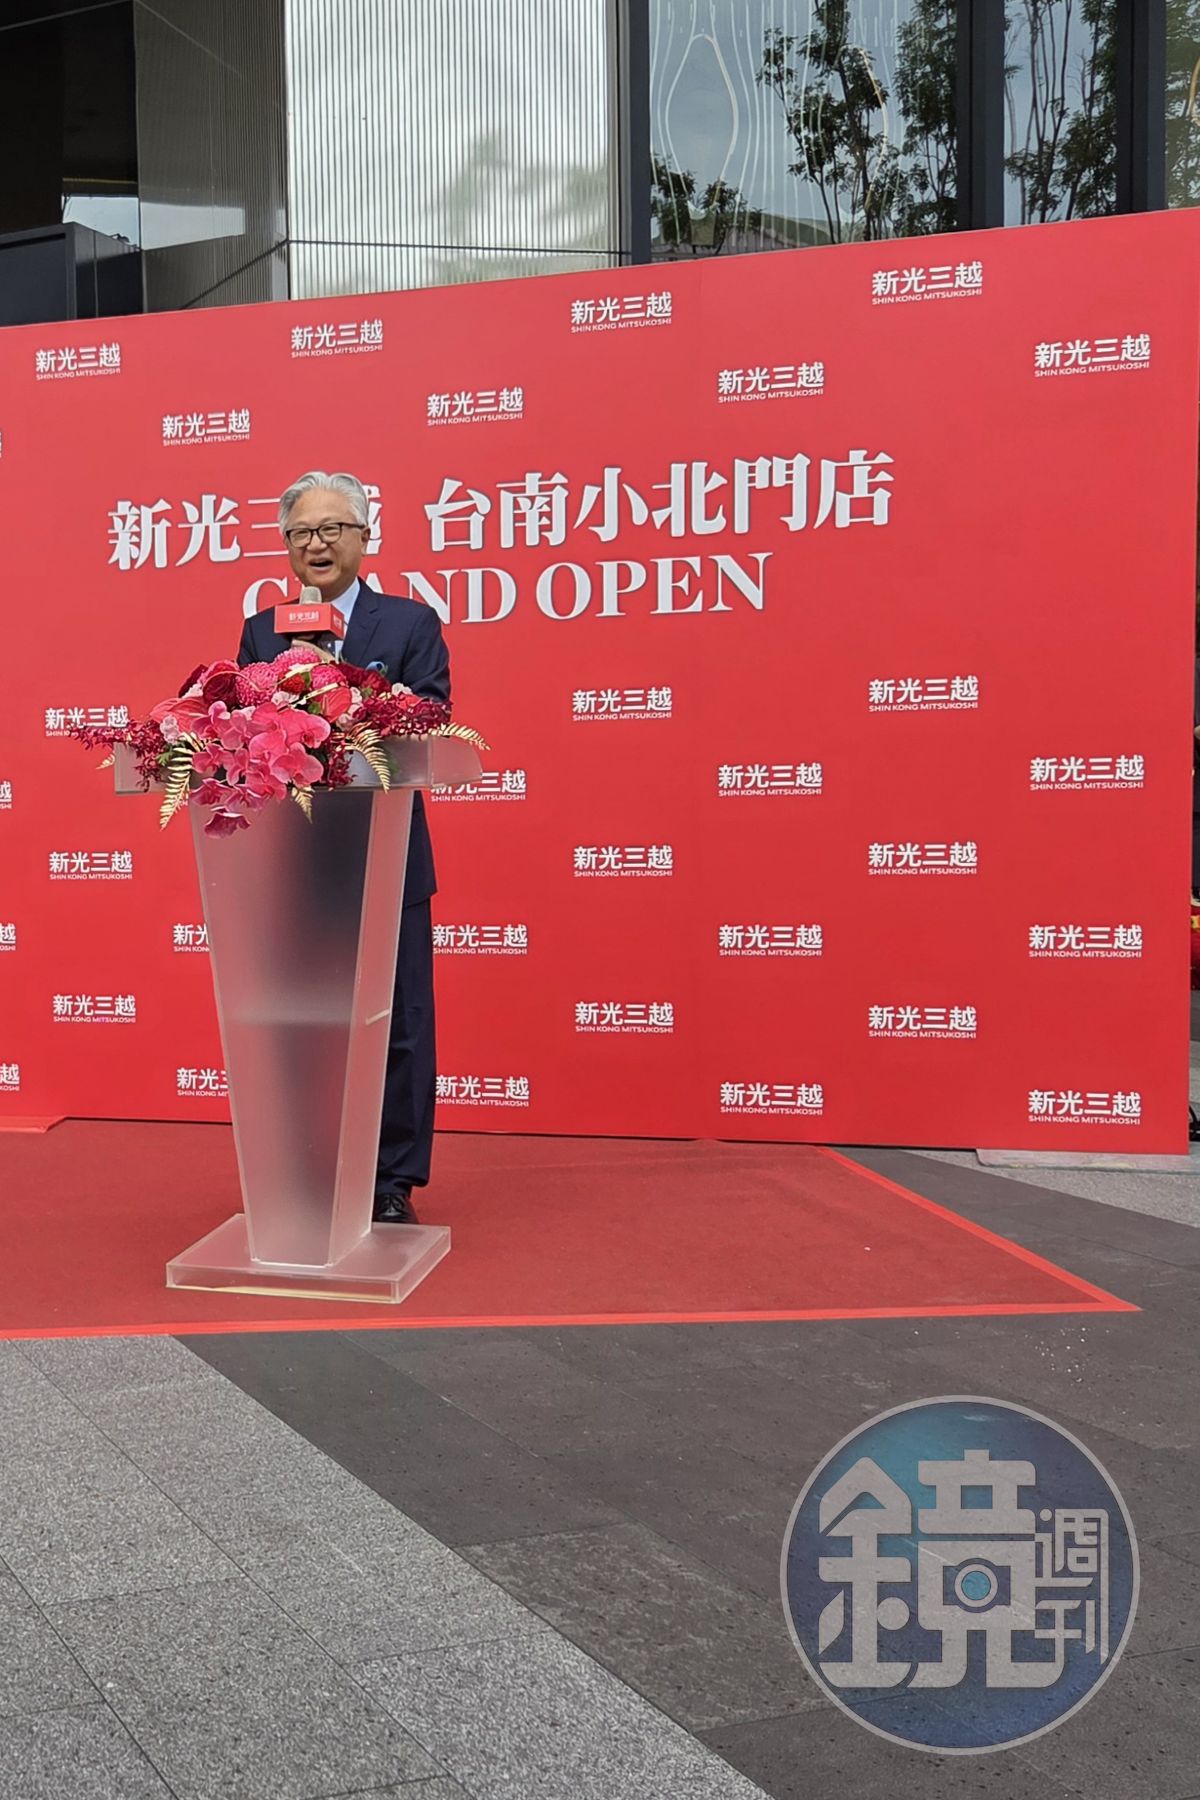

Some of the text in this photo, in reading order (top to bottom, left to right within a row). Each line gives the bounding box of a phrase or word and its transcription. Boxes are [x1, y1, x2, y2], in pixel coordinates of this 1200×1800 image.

[872, 261, 982, 295] 新光三越
[571, 291, 672, 323] 新光三越
[872, 288, 982, 305] SHIN KONG MITSUKOSHI
[292, 319, 383, 349] 新光三越
[571, 318, 671, 333] SHIN KONG MITSUKOSHI
[36, 342, 120, 371] 新光三越
[292, 344, 382, 358] SHIN KONG MITSUKOSHI
[1035, 334, 1150, 367] 新光三越
[54, 371, 75, 379] KONG
[76, 368, 120, 377] MITSUKOSHI
[718, 361, 824, 393] 新光三越
[1035, 361, 1149, 377] SHIN KONG MITSUKOSHI
[427, 387, 523, 416] 新光三越
[719, 388, 823, 403] SHIN KONG MITSUKOSHI
[163, 408, 250, 436] 新光三越
[448, 416, 471, 424] KONG
[472, 413, 522, 422] MITSUKOSHI
[163, 434, 249, 446] SHIN KONG MITSUKOSHI
[107, 449, 894, 571] 新光三 台南小北門店
[536, 552, 773, 621] OPEN
[573, 686, 672, 711] 新光三越
[869, 675, 978, 702] 新光三越
[45, 705, 130, 729] 新光三越
[573, 713, 593, 721] SHIN
[619, 711, 671, 720] MITSUKOSHI
[869, 702, 977, 712] SHIN KONG MITSUKOSHI
[718, 762, 822, 789] 新光三越
[1030, 754, 1144, 782] 新光三越
[740, 788, 765, 796] KONG
[1030, 781, 1143, 790] SHIN KONG MITSUKOSHI
[49, 851, 132, 873] 新光三越
[574, 845, 673, 869] 新光三越
[869, 841, 977, 867] 新光三越
[919, 867, 976, 875] MITSUKOSHI
[433, 925, 527, 948] 新光三越
[719, 924, 822, 949] 新光三越
[1029, 924, 1142, 950] 新光三越
[477, 947, 527, 955] MITSUKOSHI
[1081, 950, 1141, 958] MITSUKOSHI
[53, 994, 136, 1015] 新光三越
[575, 1001, 673, 1025] 新光三越
[869, 1005, 977, 1030] 新光三越
[621, 1026, 673, 1034] MITSUKOSHI
[869, 1029, 976, 1039] SHIN KONG MITSUKOSHI
[436, 1075, 529, 1098] 新光三越
[720, 1082, 823, 1107] 新光三越
[436, 1097, 455, 1105] SHIN
[479, 1099, 528, 1107] MITSUKOSHI
[721, 1105, 822, 1116] SHIN KONG MITSUKOSHI
[1029, 1089, 1141, 1116] 新光三越
[1029, 1114, 1140, 1125] SHIN KONG MITSUKOSHI
